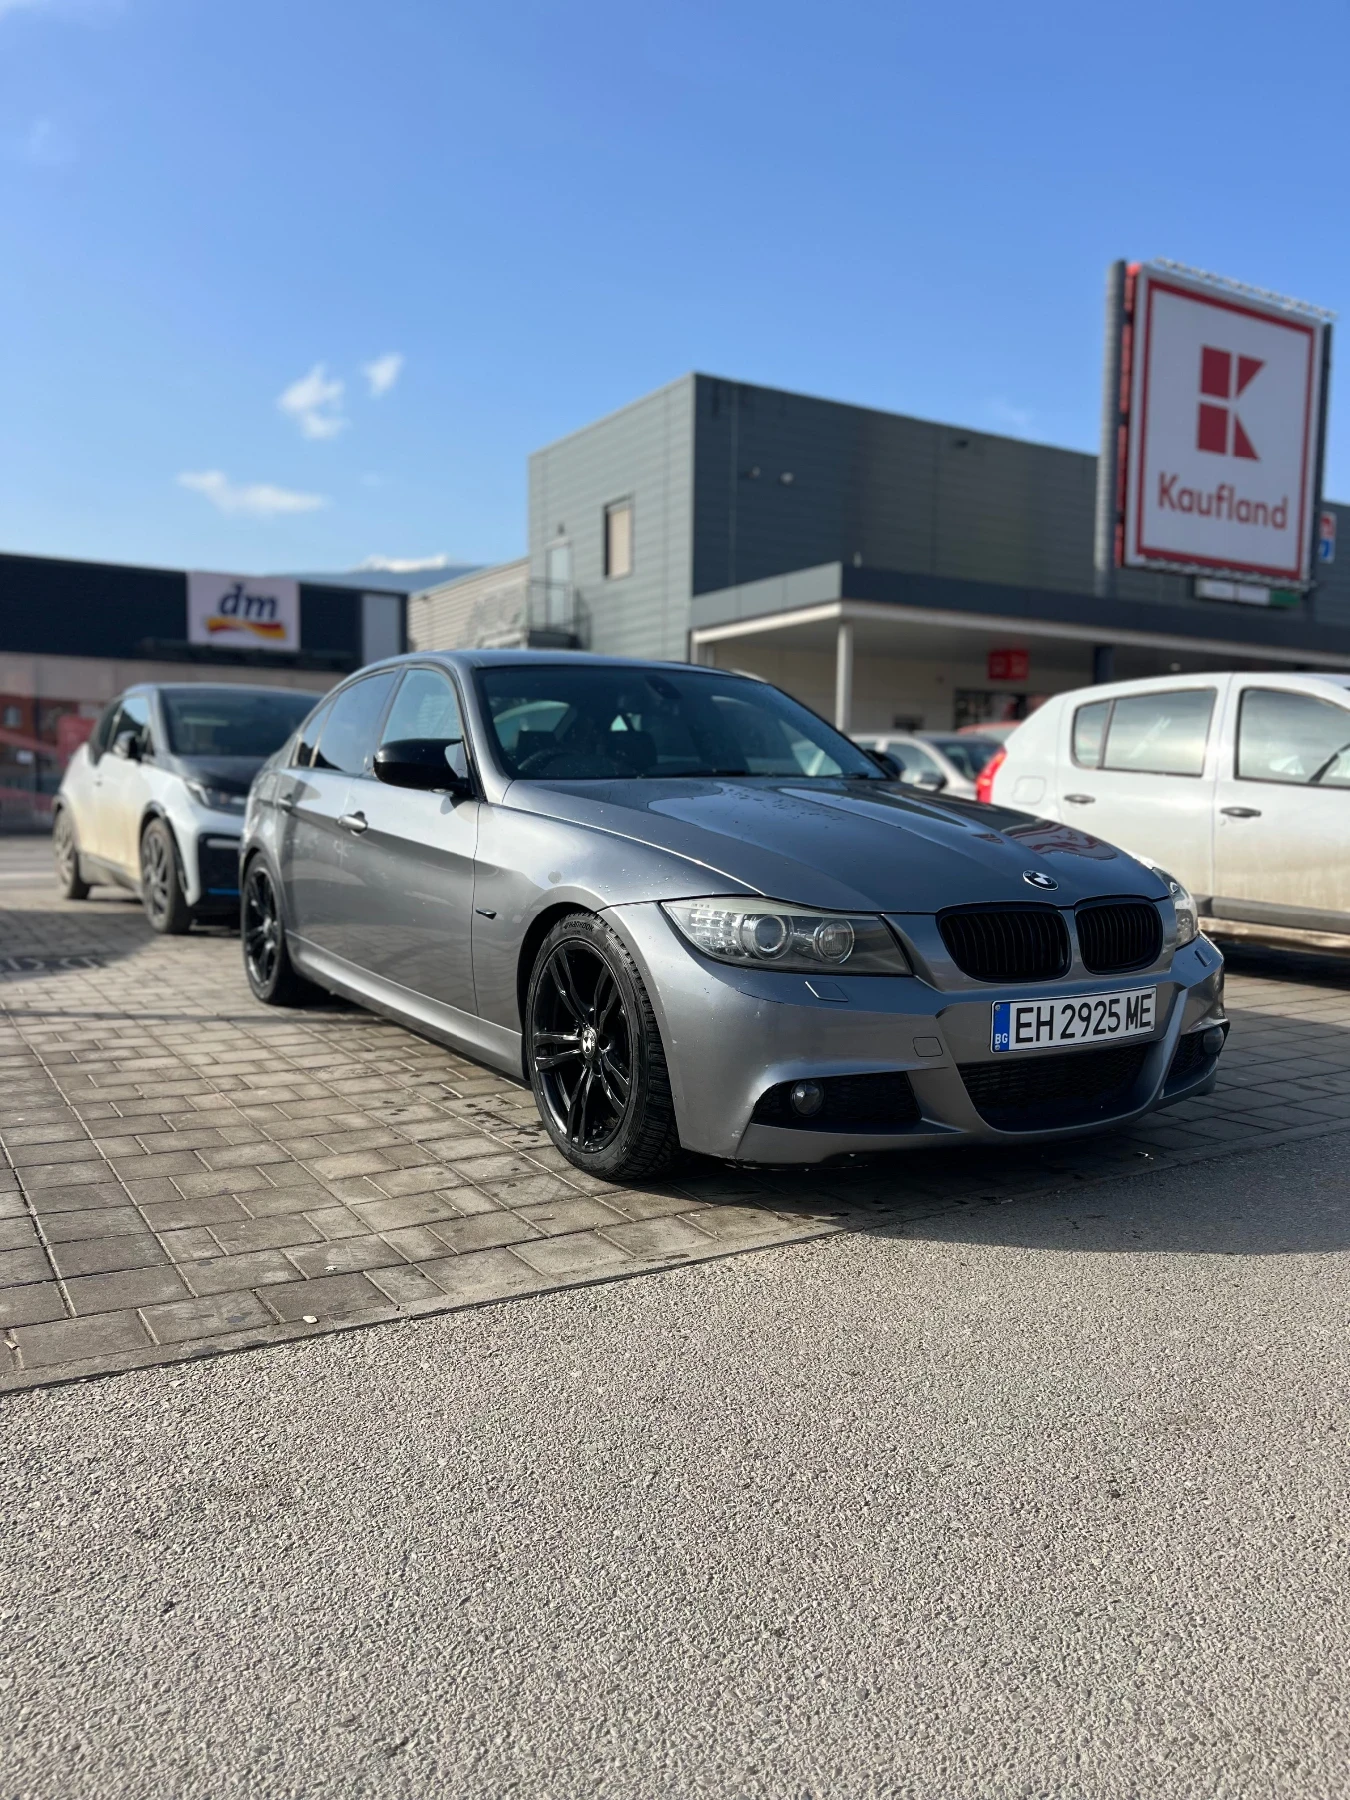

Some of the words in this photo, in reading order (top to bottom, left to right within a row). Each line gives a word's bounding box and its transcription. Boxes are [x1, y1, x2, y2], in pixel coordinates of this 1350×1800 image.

[1157, 471, 1288, 530] Kaufland
[219, 583, 277, 619] dm
[995, 1033, 1008, 1044] BG
[1015, 1005, 1055, 1044] EH
[1060, 998, 1120, 1040] 2925
[1125, 993, 1152, 1031] ME
